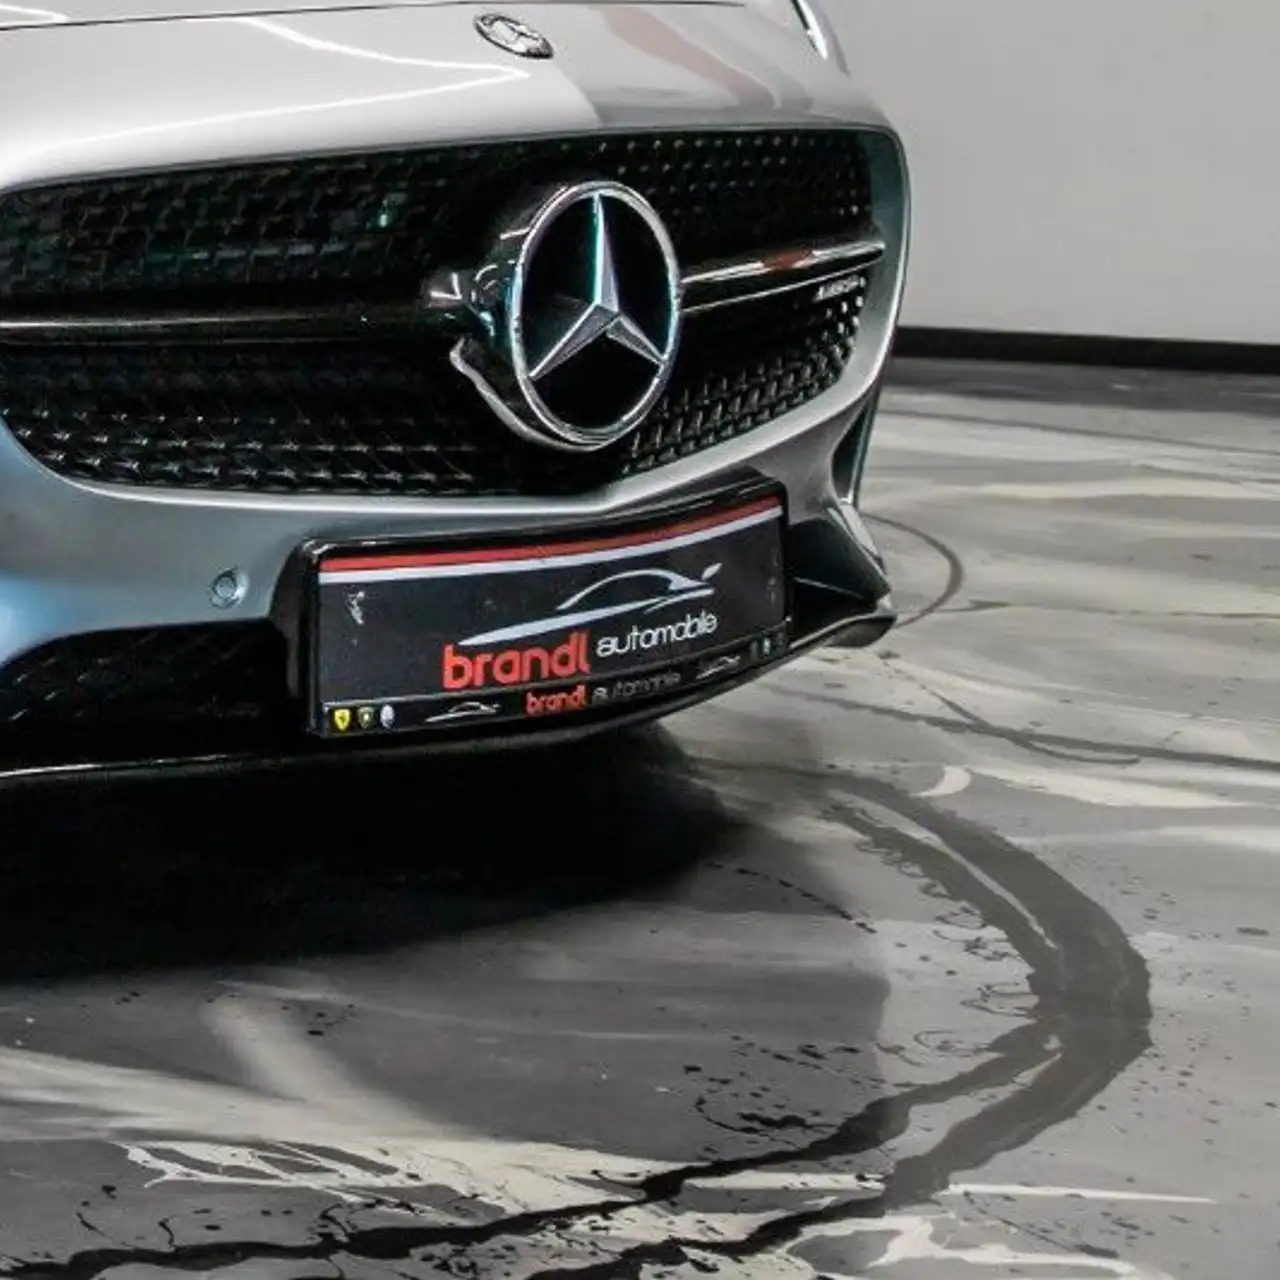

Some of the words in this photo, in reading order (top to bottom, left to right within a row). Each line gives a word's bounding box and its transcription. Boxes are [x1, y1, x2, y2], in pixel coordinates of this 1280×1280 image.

[442, 631, 591, 690] brandl
[596, 609, 718, 659] automobile
[526, 684, 586, 717] brandl
